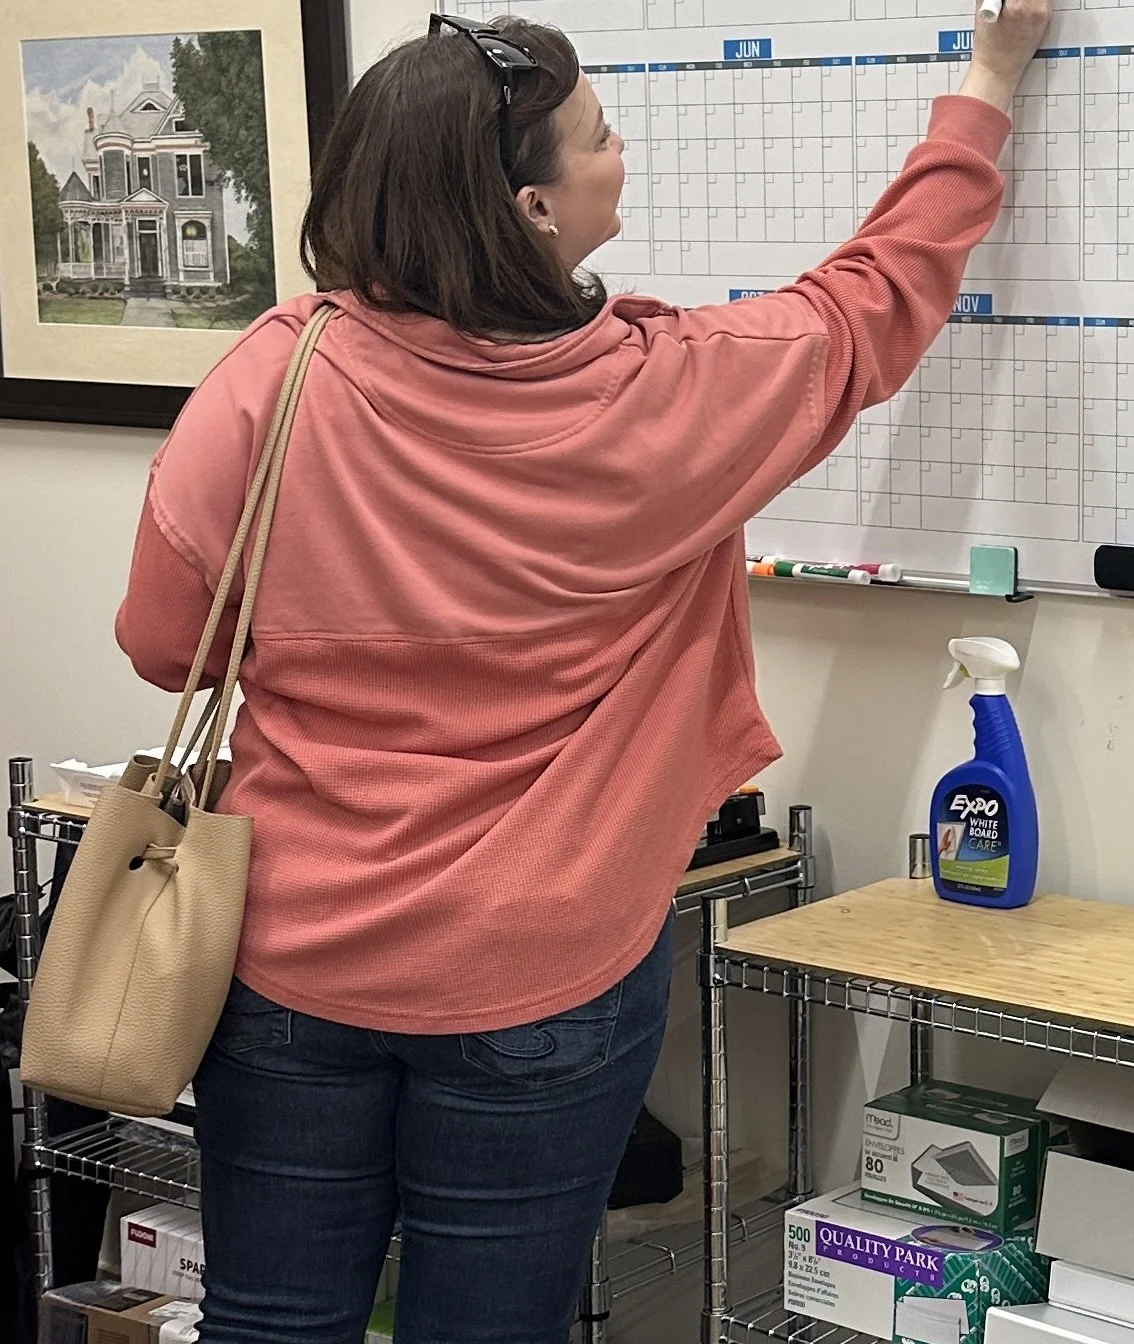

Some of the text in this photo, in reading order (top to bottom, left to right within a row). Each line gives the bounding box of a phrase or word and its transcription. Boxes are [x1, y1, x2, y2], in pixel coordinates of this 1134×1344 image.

[736, 41, 760, 58] JUN
[953, 32, 973, 50] JU
[950, 795, 998, 819] EXPO
[970, 817, 998, 830] WHITE
[969, 827, 998, 839] BOARD
[865, 1156, 884, 1174] 80
[788, 1224, 811, 1243] 500
[820, 1227, 893, 1258] QUALITY
[895, 1246, 939, 1272] PARK
